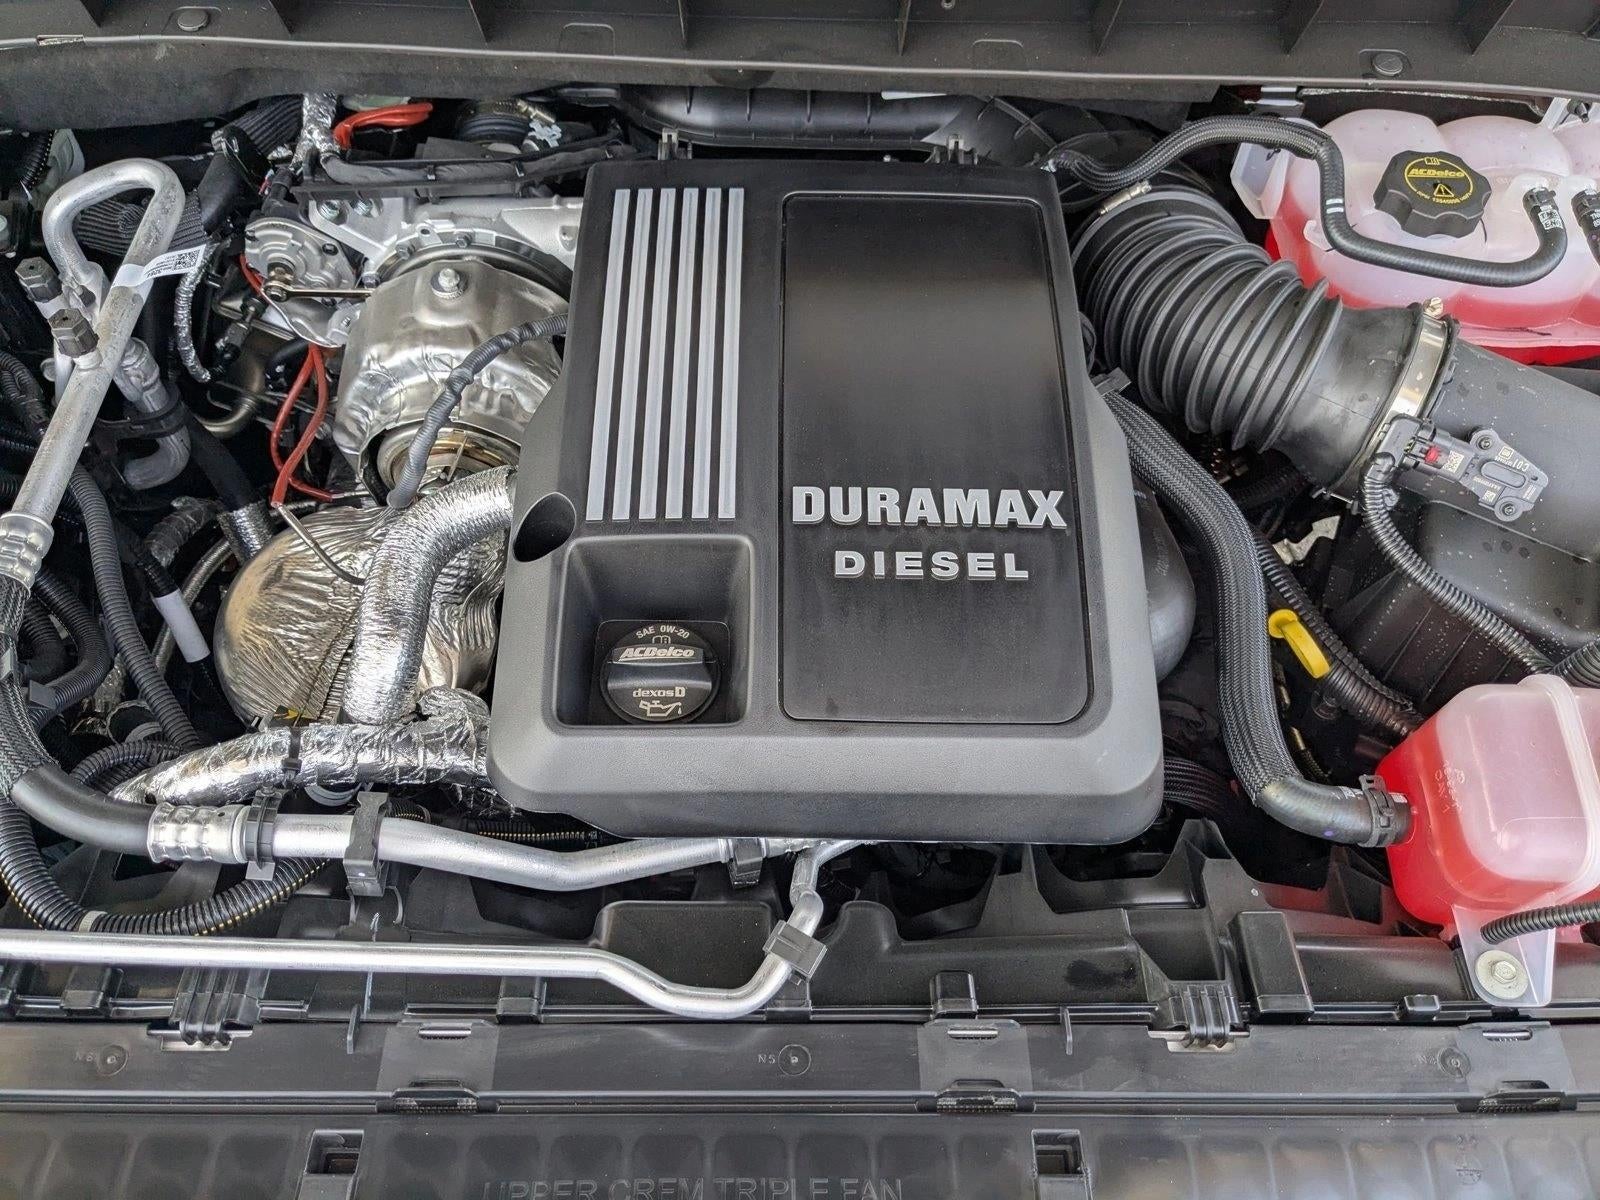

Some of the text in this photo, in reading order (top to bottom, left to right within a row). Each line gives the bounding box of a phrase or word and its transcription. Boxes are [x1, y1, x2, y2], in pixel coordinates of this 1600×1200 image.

[1407, 168, 1466, 178] ACDelco
[792, 486, 1067, 529] DURAMAX
[834, 550, 1029, 580] DIESEL
[635, 624, 690, 639] SAE 0W-20
[618, 646, 695, 661] ACDelco
[483, 1179, 598, 1200] UPPER
[712, 1177, 829, 1200] TRIPLE
[840, 1177, 902, 1200] FAN
